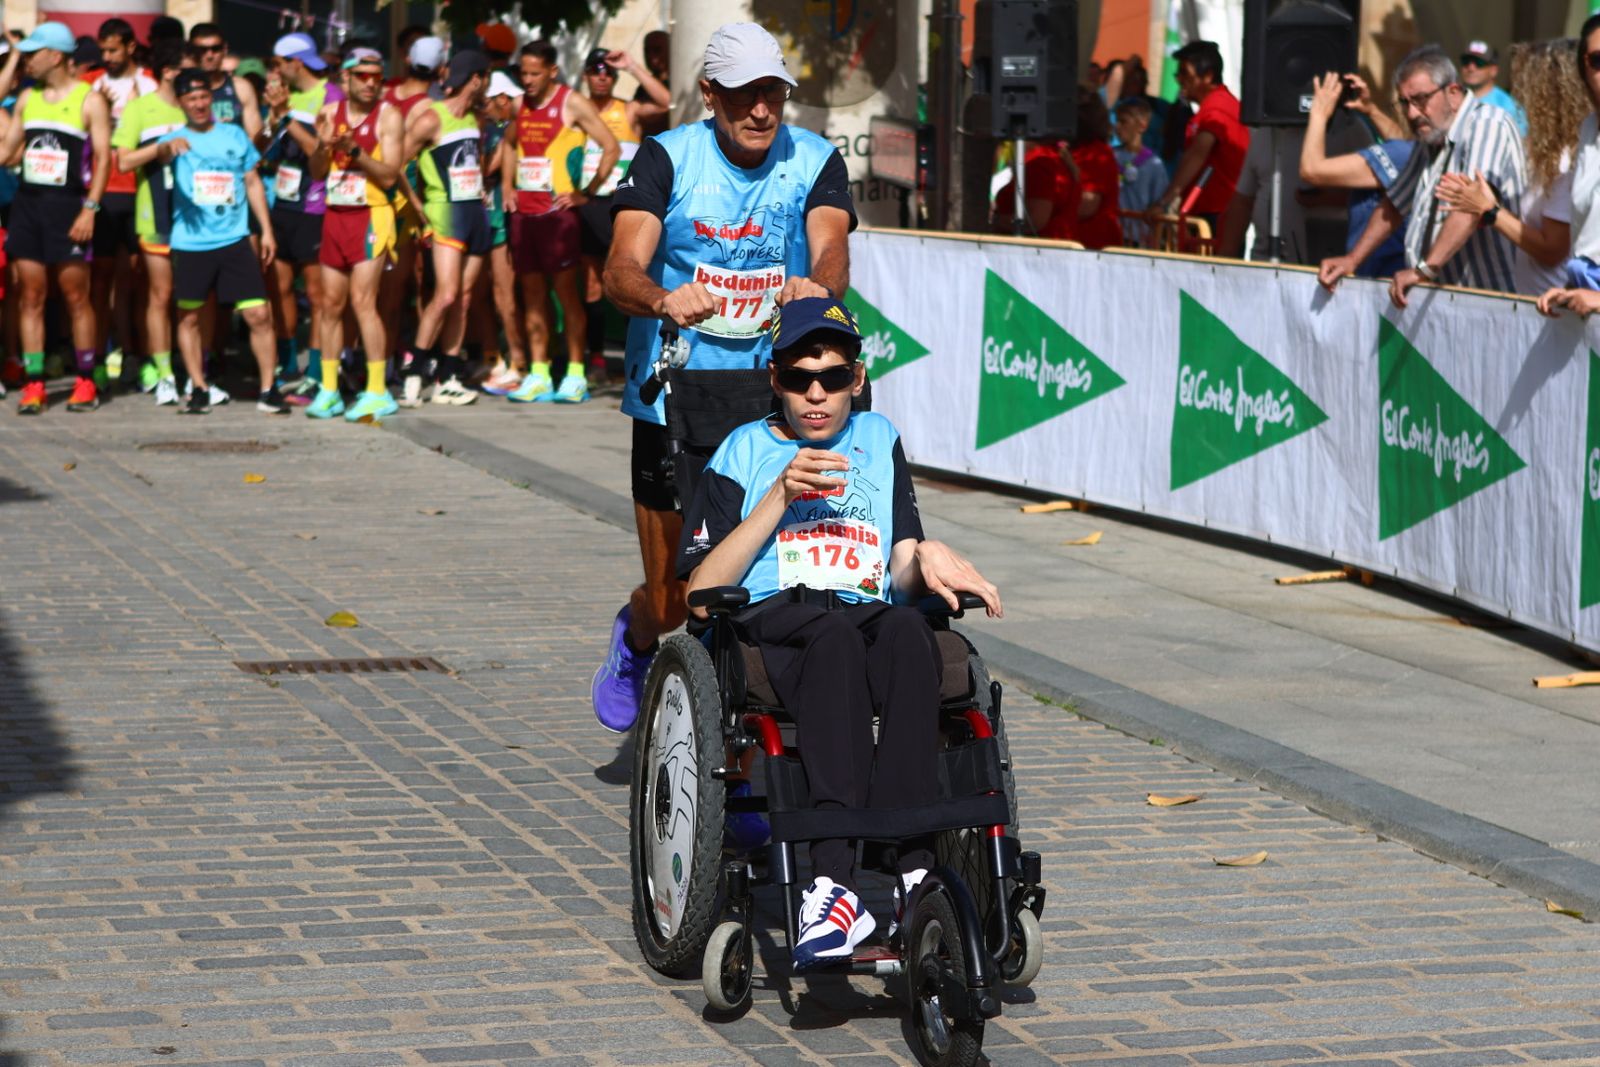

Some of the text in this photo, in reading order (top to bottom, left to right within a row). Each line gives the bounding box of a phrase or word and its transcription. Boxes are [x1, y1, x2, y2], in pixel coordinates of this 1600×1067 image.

[696, 266, 783, 291] bedunia
[719, 296, 763, 319] 177
[984, 336, 1092, 400] El Corte Inglés
[1179, 364, 1294, 436] El Corte Inglés
[1382, 399, 1490, 483] El Corte Inglés
[779, 523, 878, 547] bedunia
[807, 544, 860, 570] 176
